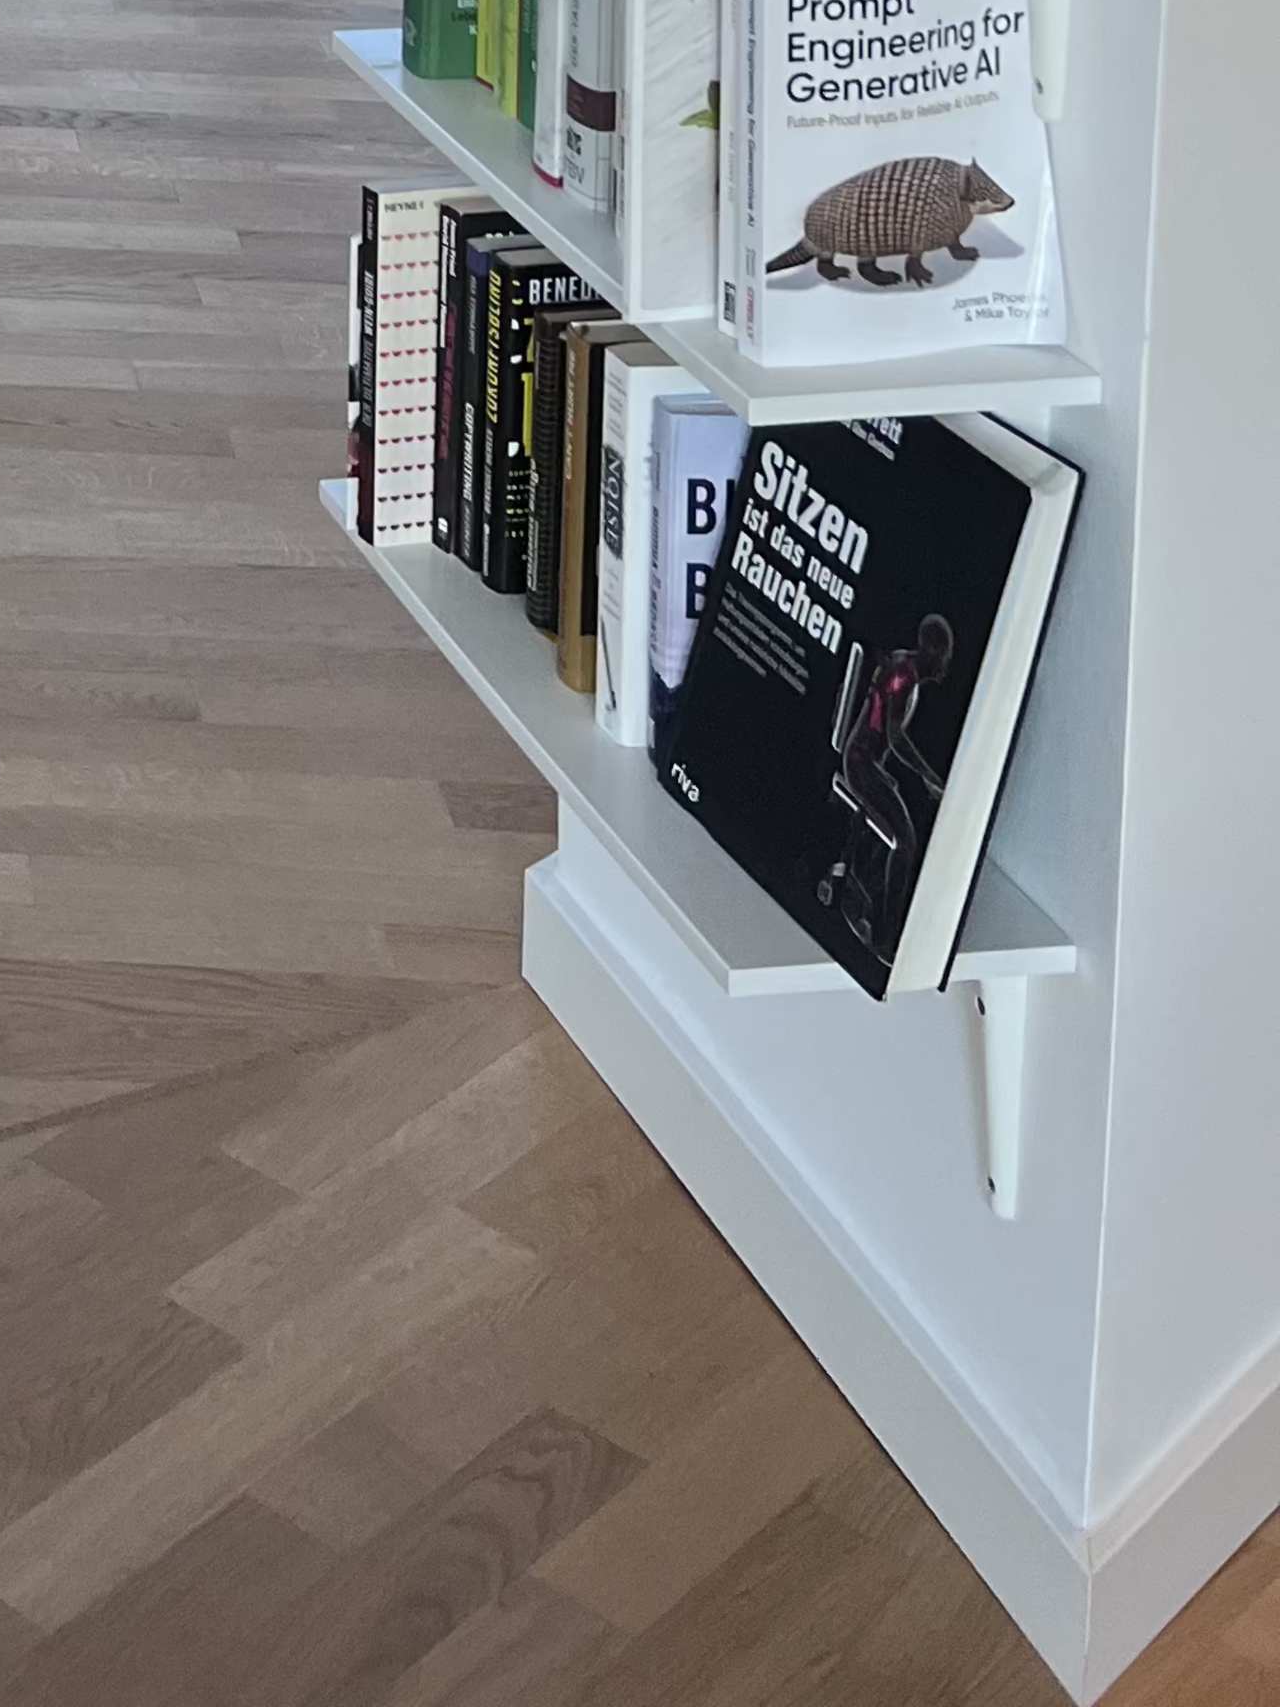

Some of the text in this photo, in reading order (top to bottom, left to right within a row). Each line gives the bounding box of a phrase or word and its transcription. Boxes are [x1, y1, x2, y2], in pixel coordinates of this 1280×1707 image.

[786, 45, 1001, 103] Generative AI
[787, 7, 1025, 69] Engineering for
[787, 113, 861, 130] Future-Proof
[864, 111, 898, 127] Inputs
[901, 108, 914, 121] for
[449, 250, 458, 278] Fried
[463, 402, 475, 501] COPYWRITING
[606, 456, 622, 545] NOISE
[753, 440, 870, 575] Sitzen
[742, 498, 855, 610] ist das neue
[730, 530, 844, 655] Rauchen
[670, 762, 701, 804] riva
